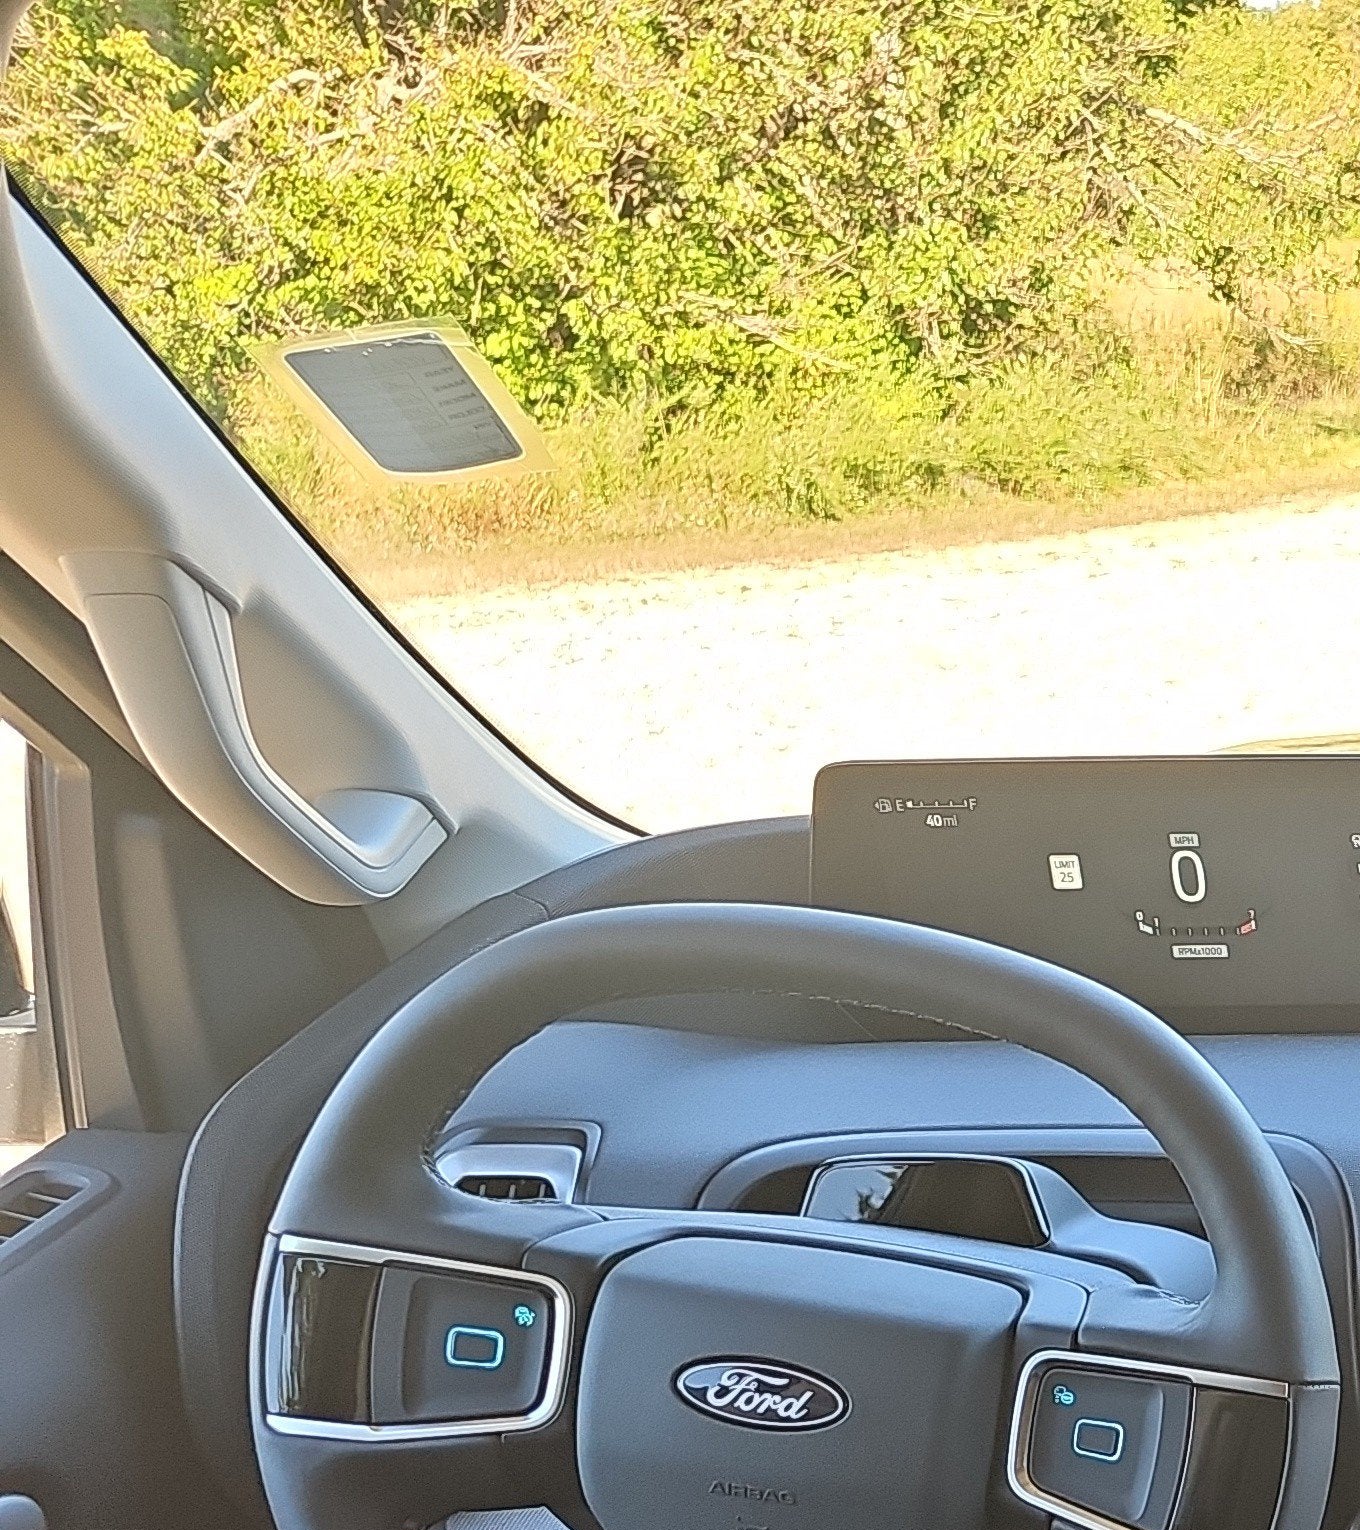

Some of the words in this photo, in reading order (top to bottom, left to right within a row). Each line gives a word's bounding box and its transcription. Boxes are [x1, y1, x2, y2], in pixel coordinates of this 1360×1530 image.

[1173, 835, 1195, 845] MPH
[1054, 860, 1076, 869] LIMIT
[1060, 872, 1075, 883] 25
[1170, 849, 1207, 903] 0
[706, 1366, 814, 1421] Ford
[708, 1479, 797, 1506] AIRBAG
